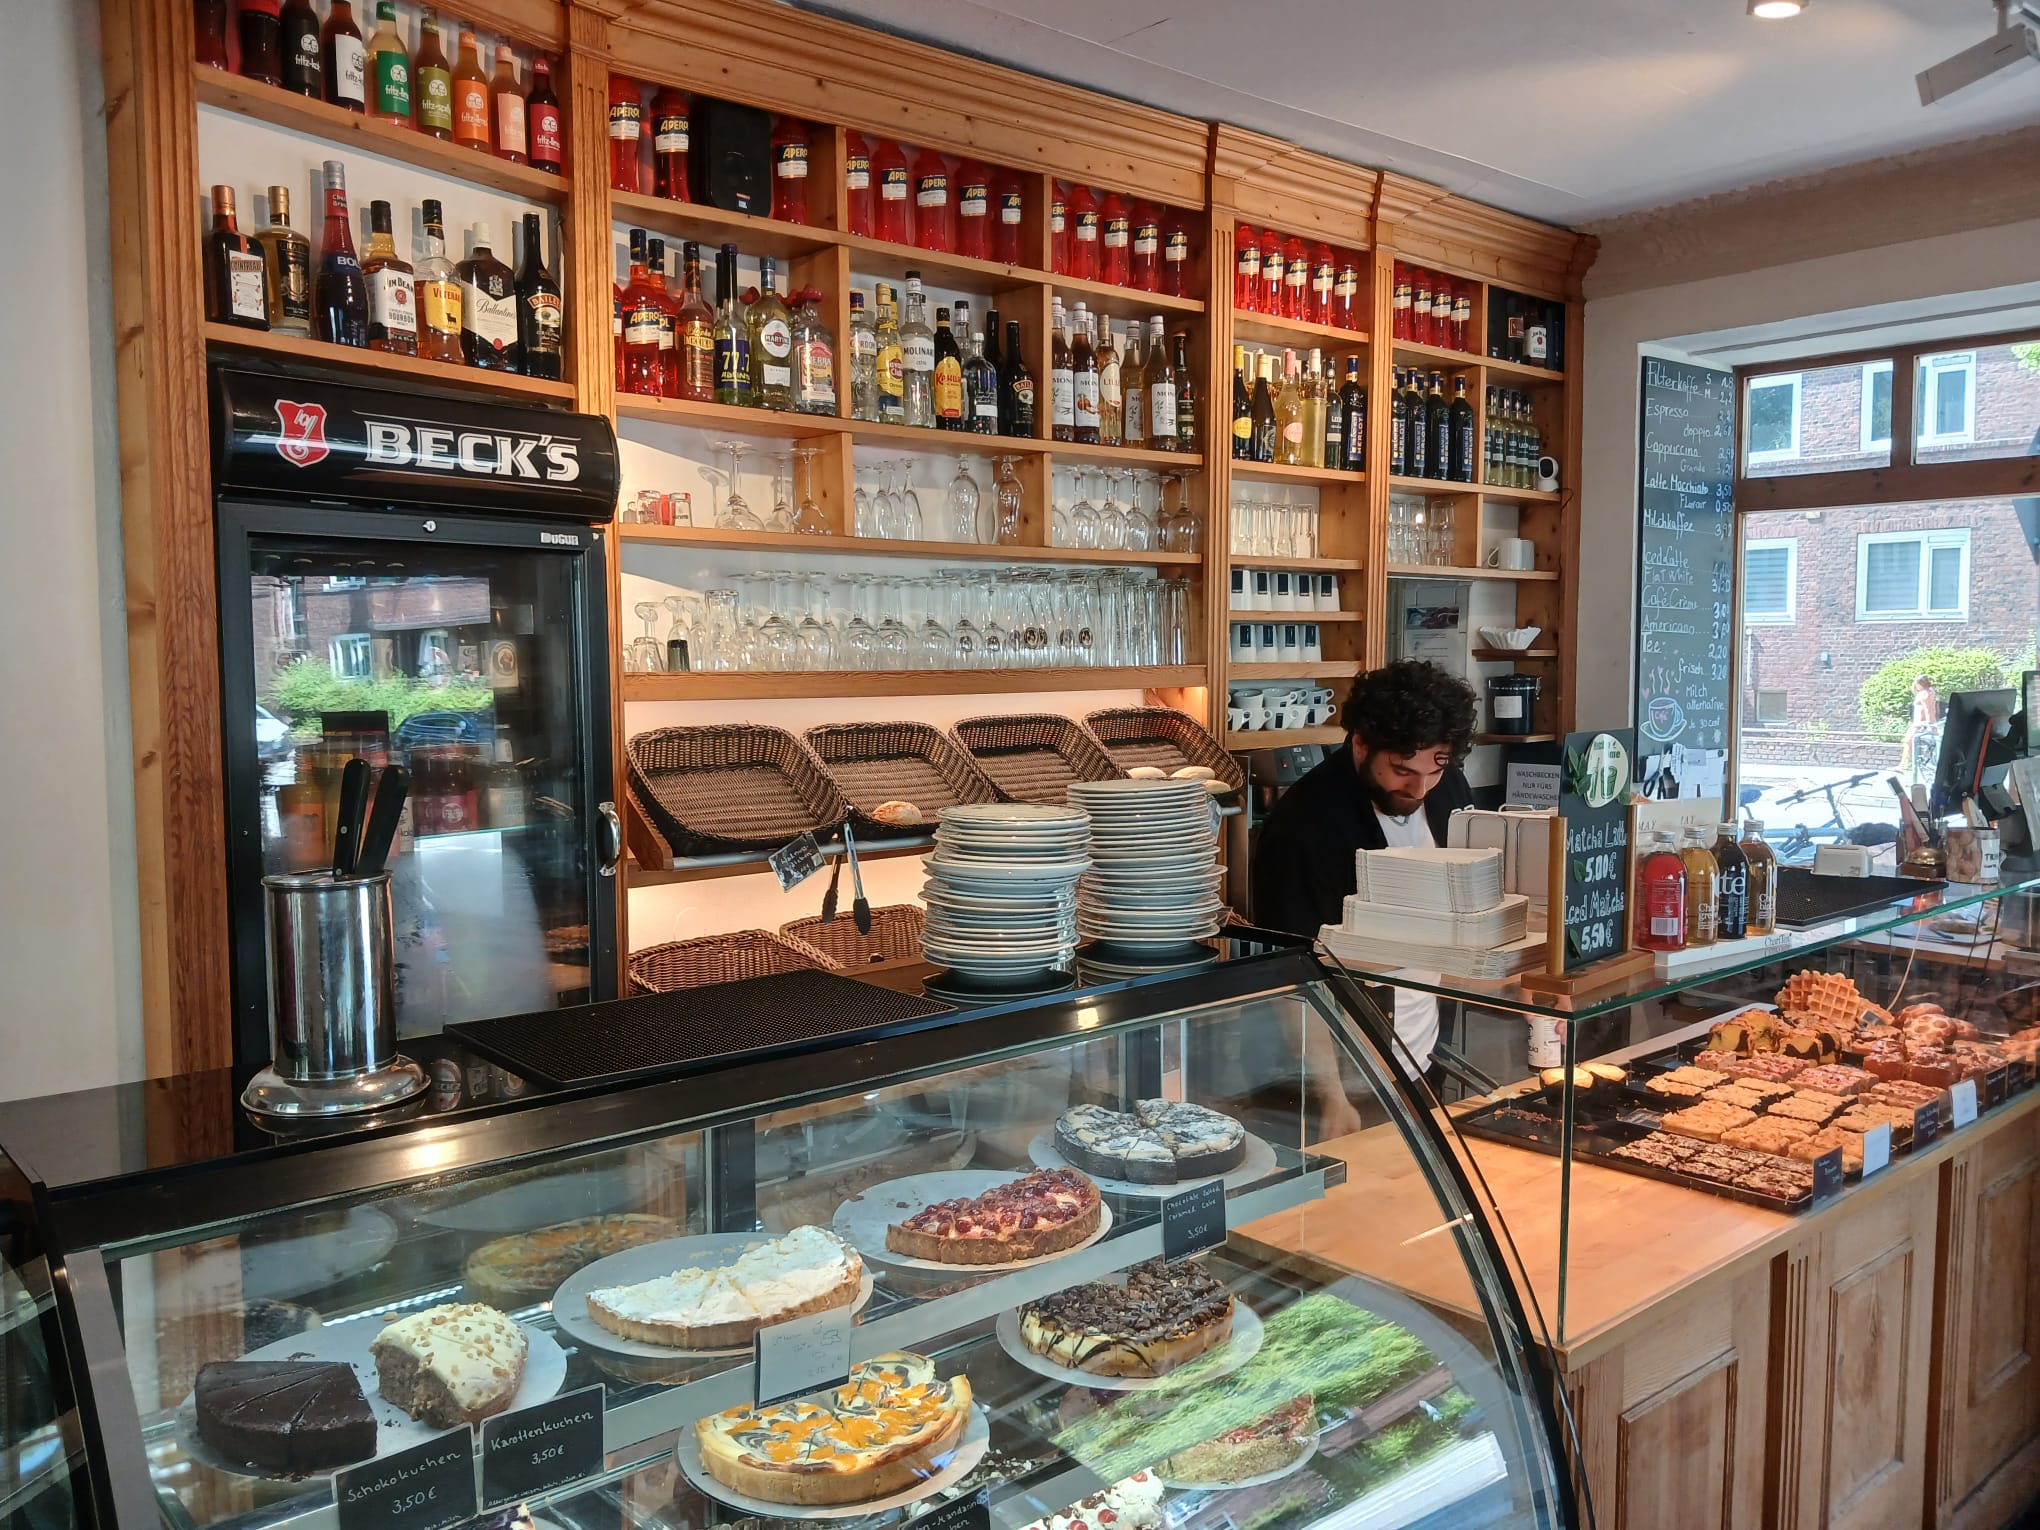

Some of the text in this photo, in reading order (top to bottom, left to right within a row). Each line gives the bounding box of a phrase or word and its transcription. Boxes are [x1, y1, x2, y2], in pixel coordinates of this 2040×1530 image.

[609, 105, 641, 118] APERO
[661, 119, 689, 132] APERO
[1646, 397, 1688, 424] Espresso
[363, 420, 580, 482] BECK'S
[1646, 432, 1698, 464] Cappuccino
[1645, 467, 1668, 489] Latte
[1643, 614, 1695, 635] Americano
[1674, 657, 1704, 684] frisch
[1686, 684, 1708, 697] Milch
[1516, 771, 1560, 779] WASCHBECKEN
[490, 1411, 594, 1452] Karottenkuchen
[347, 1451, 461, 1502] Schokokuchen
